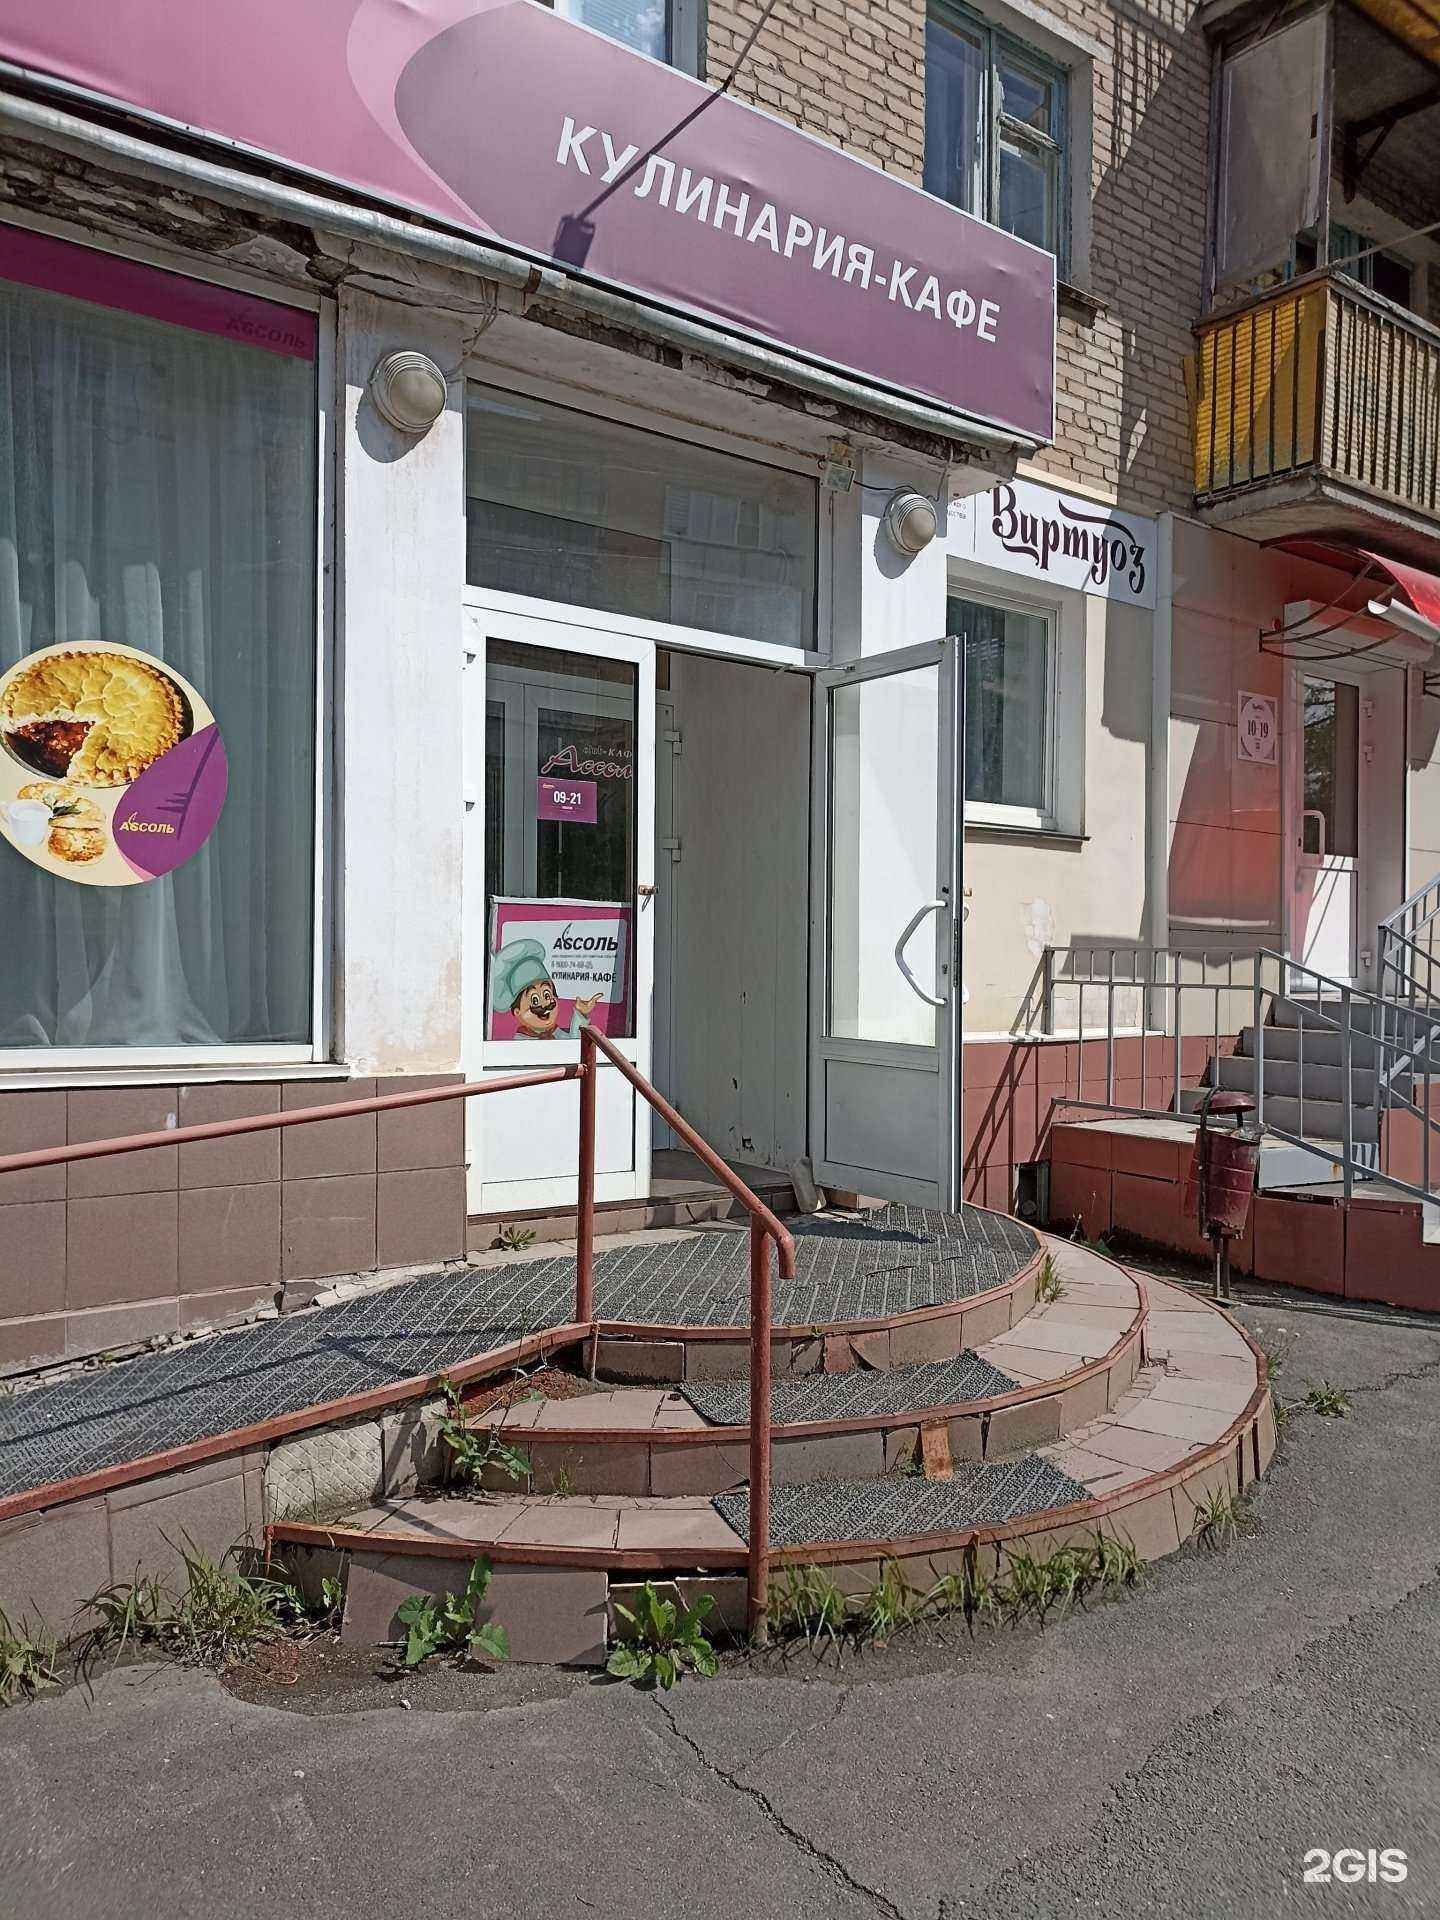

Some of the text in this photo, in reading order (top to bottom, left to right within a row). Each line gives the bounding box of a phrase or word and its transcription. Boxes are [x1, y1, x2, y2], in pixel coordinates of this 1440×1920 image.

[555, 116, 1001, 343] КУЛИНАРИЯ-КАФЕ
[992, 484, 1146, 594] Виртуоз
[553, 790, 581, 805] 09-21
[551, 971, 617, 983] КУЛИНАРИЯ-КАФЕ
